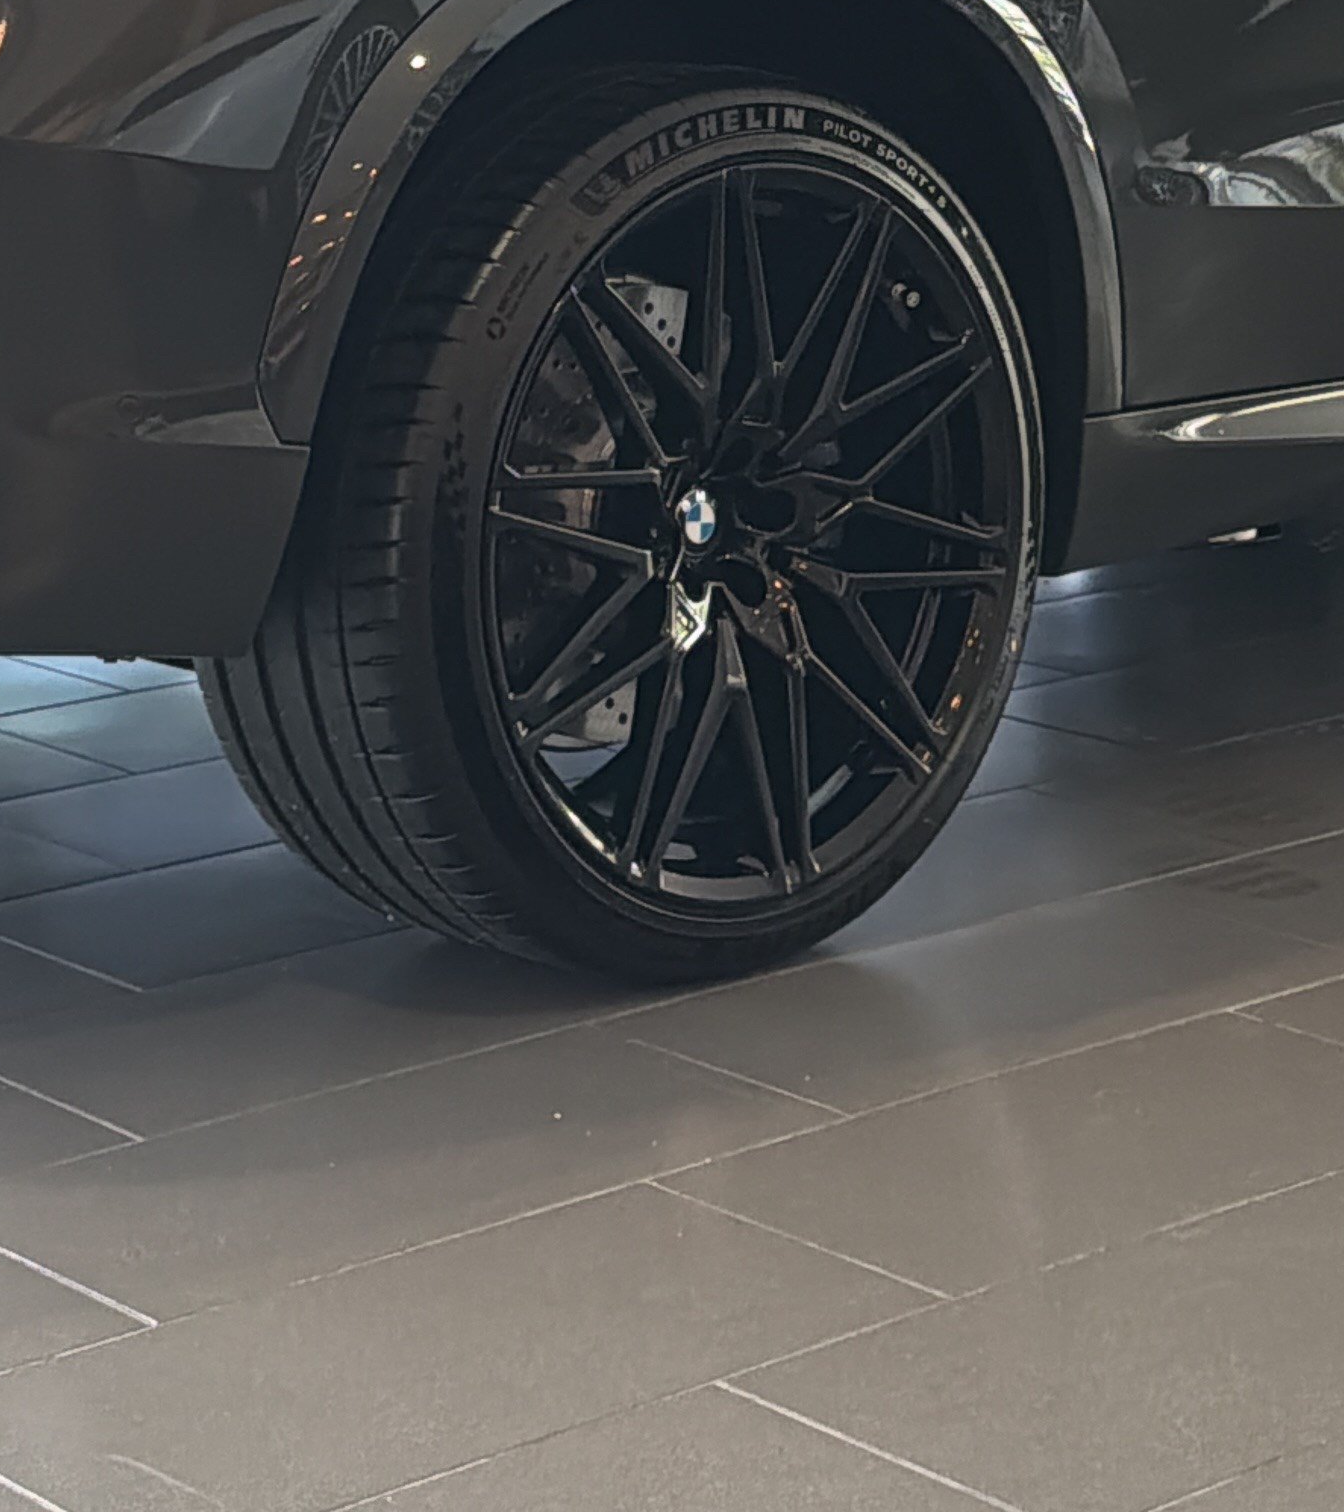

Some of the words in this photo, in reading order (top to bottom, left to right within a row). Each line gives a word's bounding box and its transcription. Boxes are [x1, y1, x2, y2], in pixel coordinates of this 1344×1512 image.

[623, 105, 806, 178] MICHELIN
[822, 118, 873, 148] PILOT
[875, 142, 930, 188] SPORT
